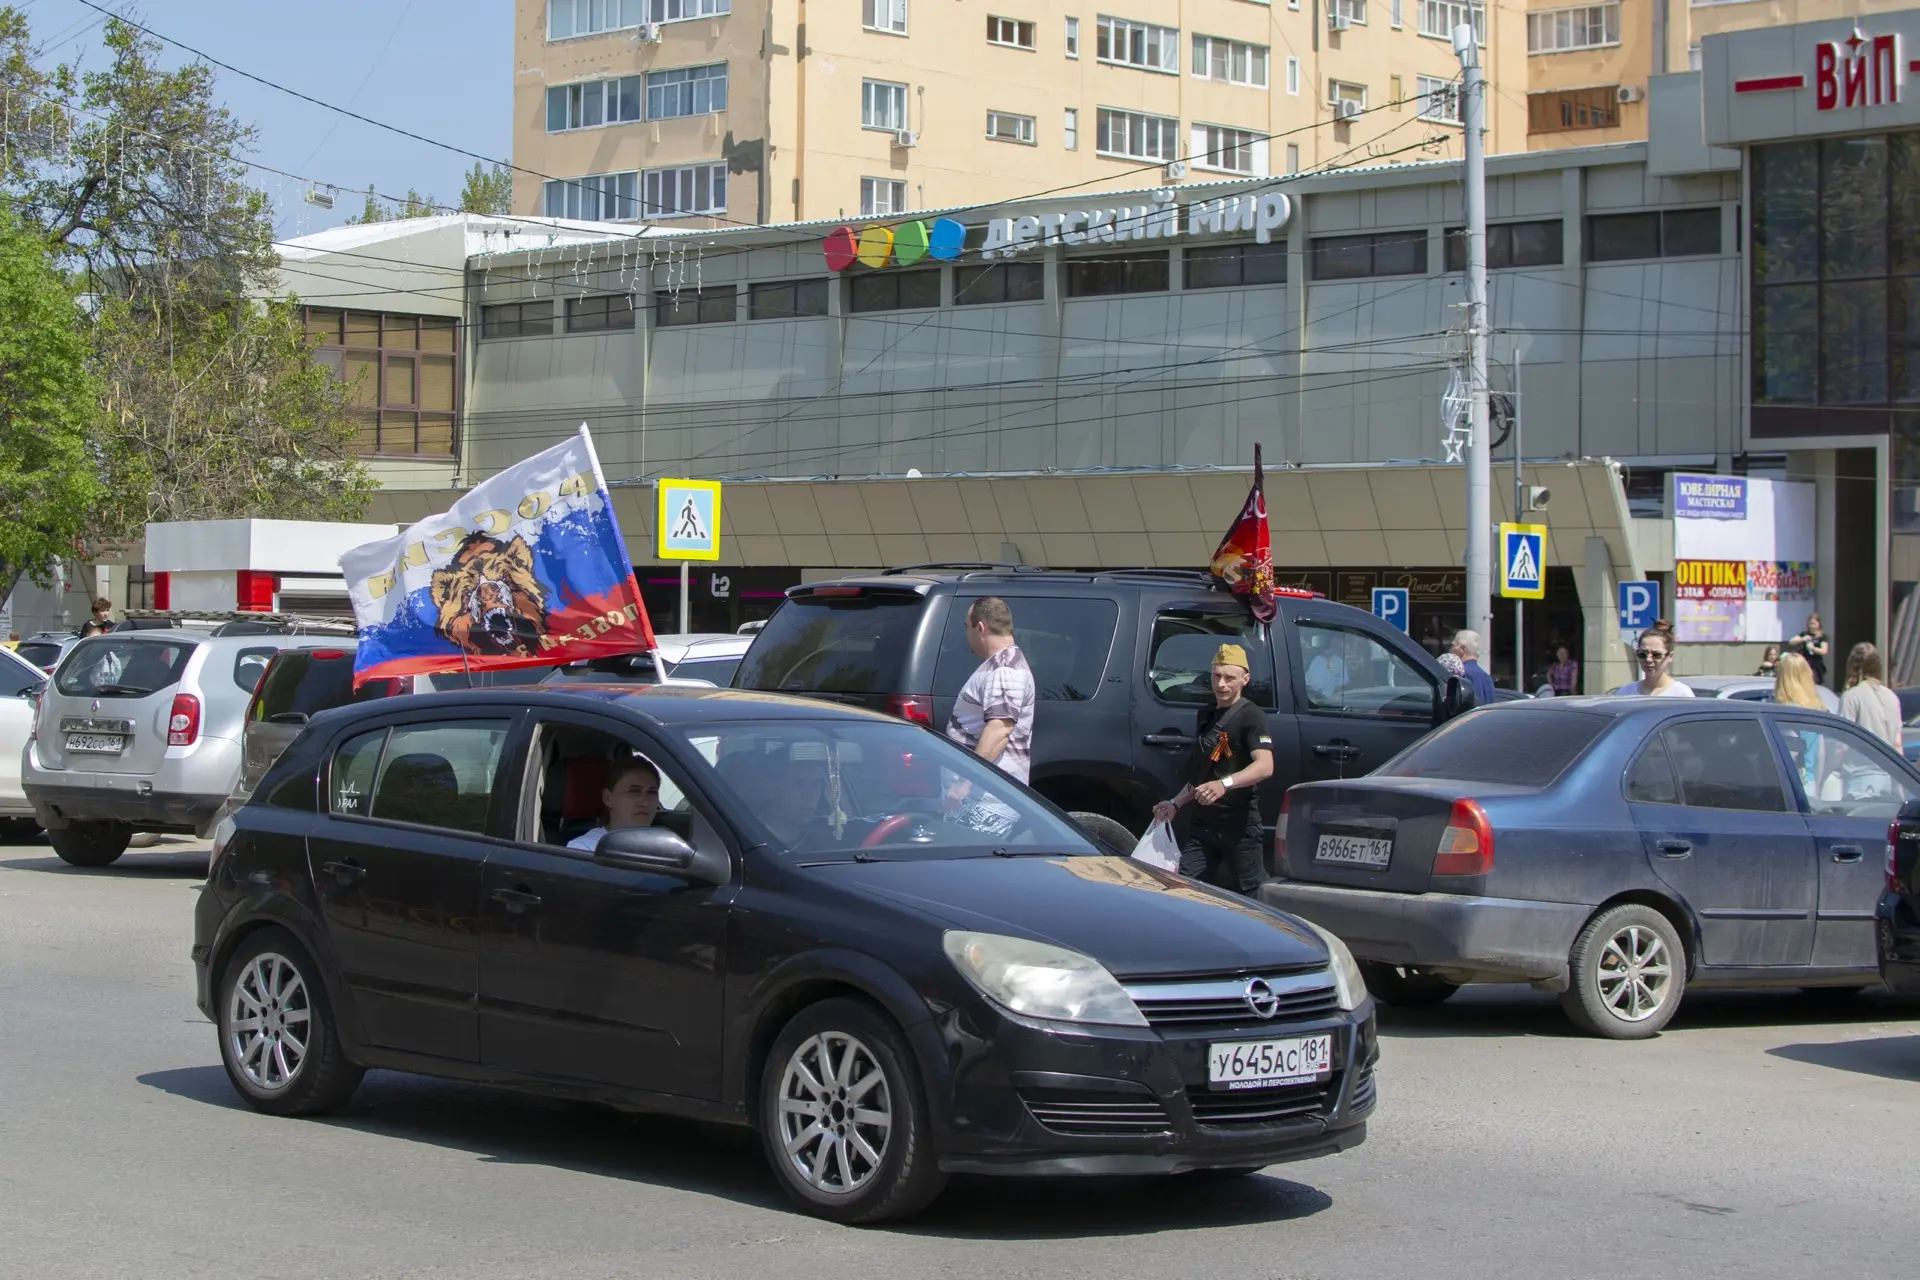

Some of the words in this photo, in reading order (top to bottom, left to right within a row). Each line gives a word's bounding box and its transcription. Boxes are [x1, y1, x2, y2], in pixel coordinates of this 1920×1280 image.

[1188, 191, 1292, 244] мир
[1680, 482, 1742, 498] ЮВЕЛИРНАЯ
[1688, 497, 1736, 508] МАСТЕРСКАЯ
[1676, 561, 1746, 586] ОПТИКА
[1677, 587, 1683, 597] 2
[1683, 587, 1705, 597] ЭТАЖ
[1320, 838, 1366, 860] В966ЕТ
[1369, 840, 1389, 857] 161
[1219, 1045, 1298, 1077] У645АС
[1301, 1038, 1326, 1062] 181
[1306, 1061, 1319, 1070] RUS
[1229, 1078, 1261, 1089] МОЛОДОЙ
[1262, 1079, 1267, 1087] И
[1268, 1074, 1317, 1086] ПЕРСПЕКТИВНЫЙ
